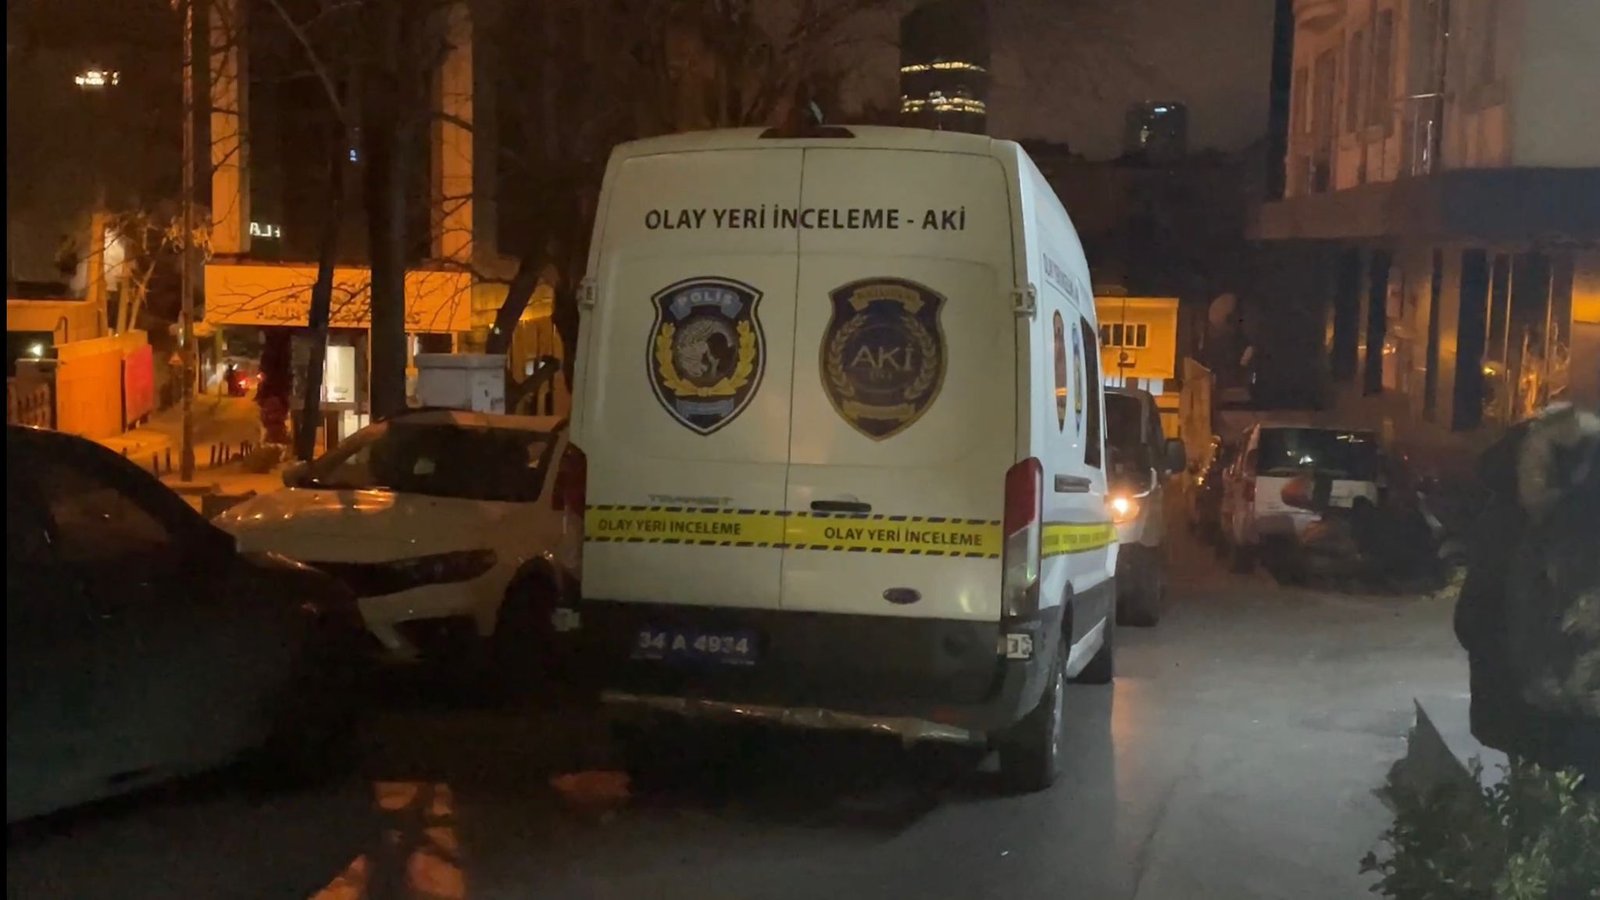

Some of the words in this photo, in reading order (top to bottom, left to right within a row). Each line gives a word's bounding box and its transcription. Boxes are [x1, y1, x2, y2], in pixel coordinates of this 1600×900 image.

[644, 208, 707, 230] OLAY
[712, 204, 766, 230] YERİ
[772, 204, 900, 230] İNCELEME
[921, 206, 966, 231] AKİ
[850, 342, 915, 371] AKİ
[597, 518, 633, 532] OLAY
[824, 526, 864, 541] OLAY
[867, 527, 900, 542] YERİ
[904, 528, 983, 547] İNCELEME
[639, 631, 666, 649] 34
[672, 633, 687, 650] A
